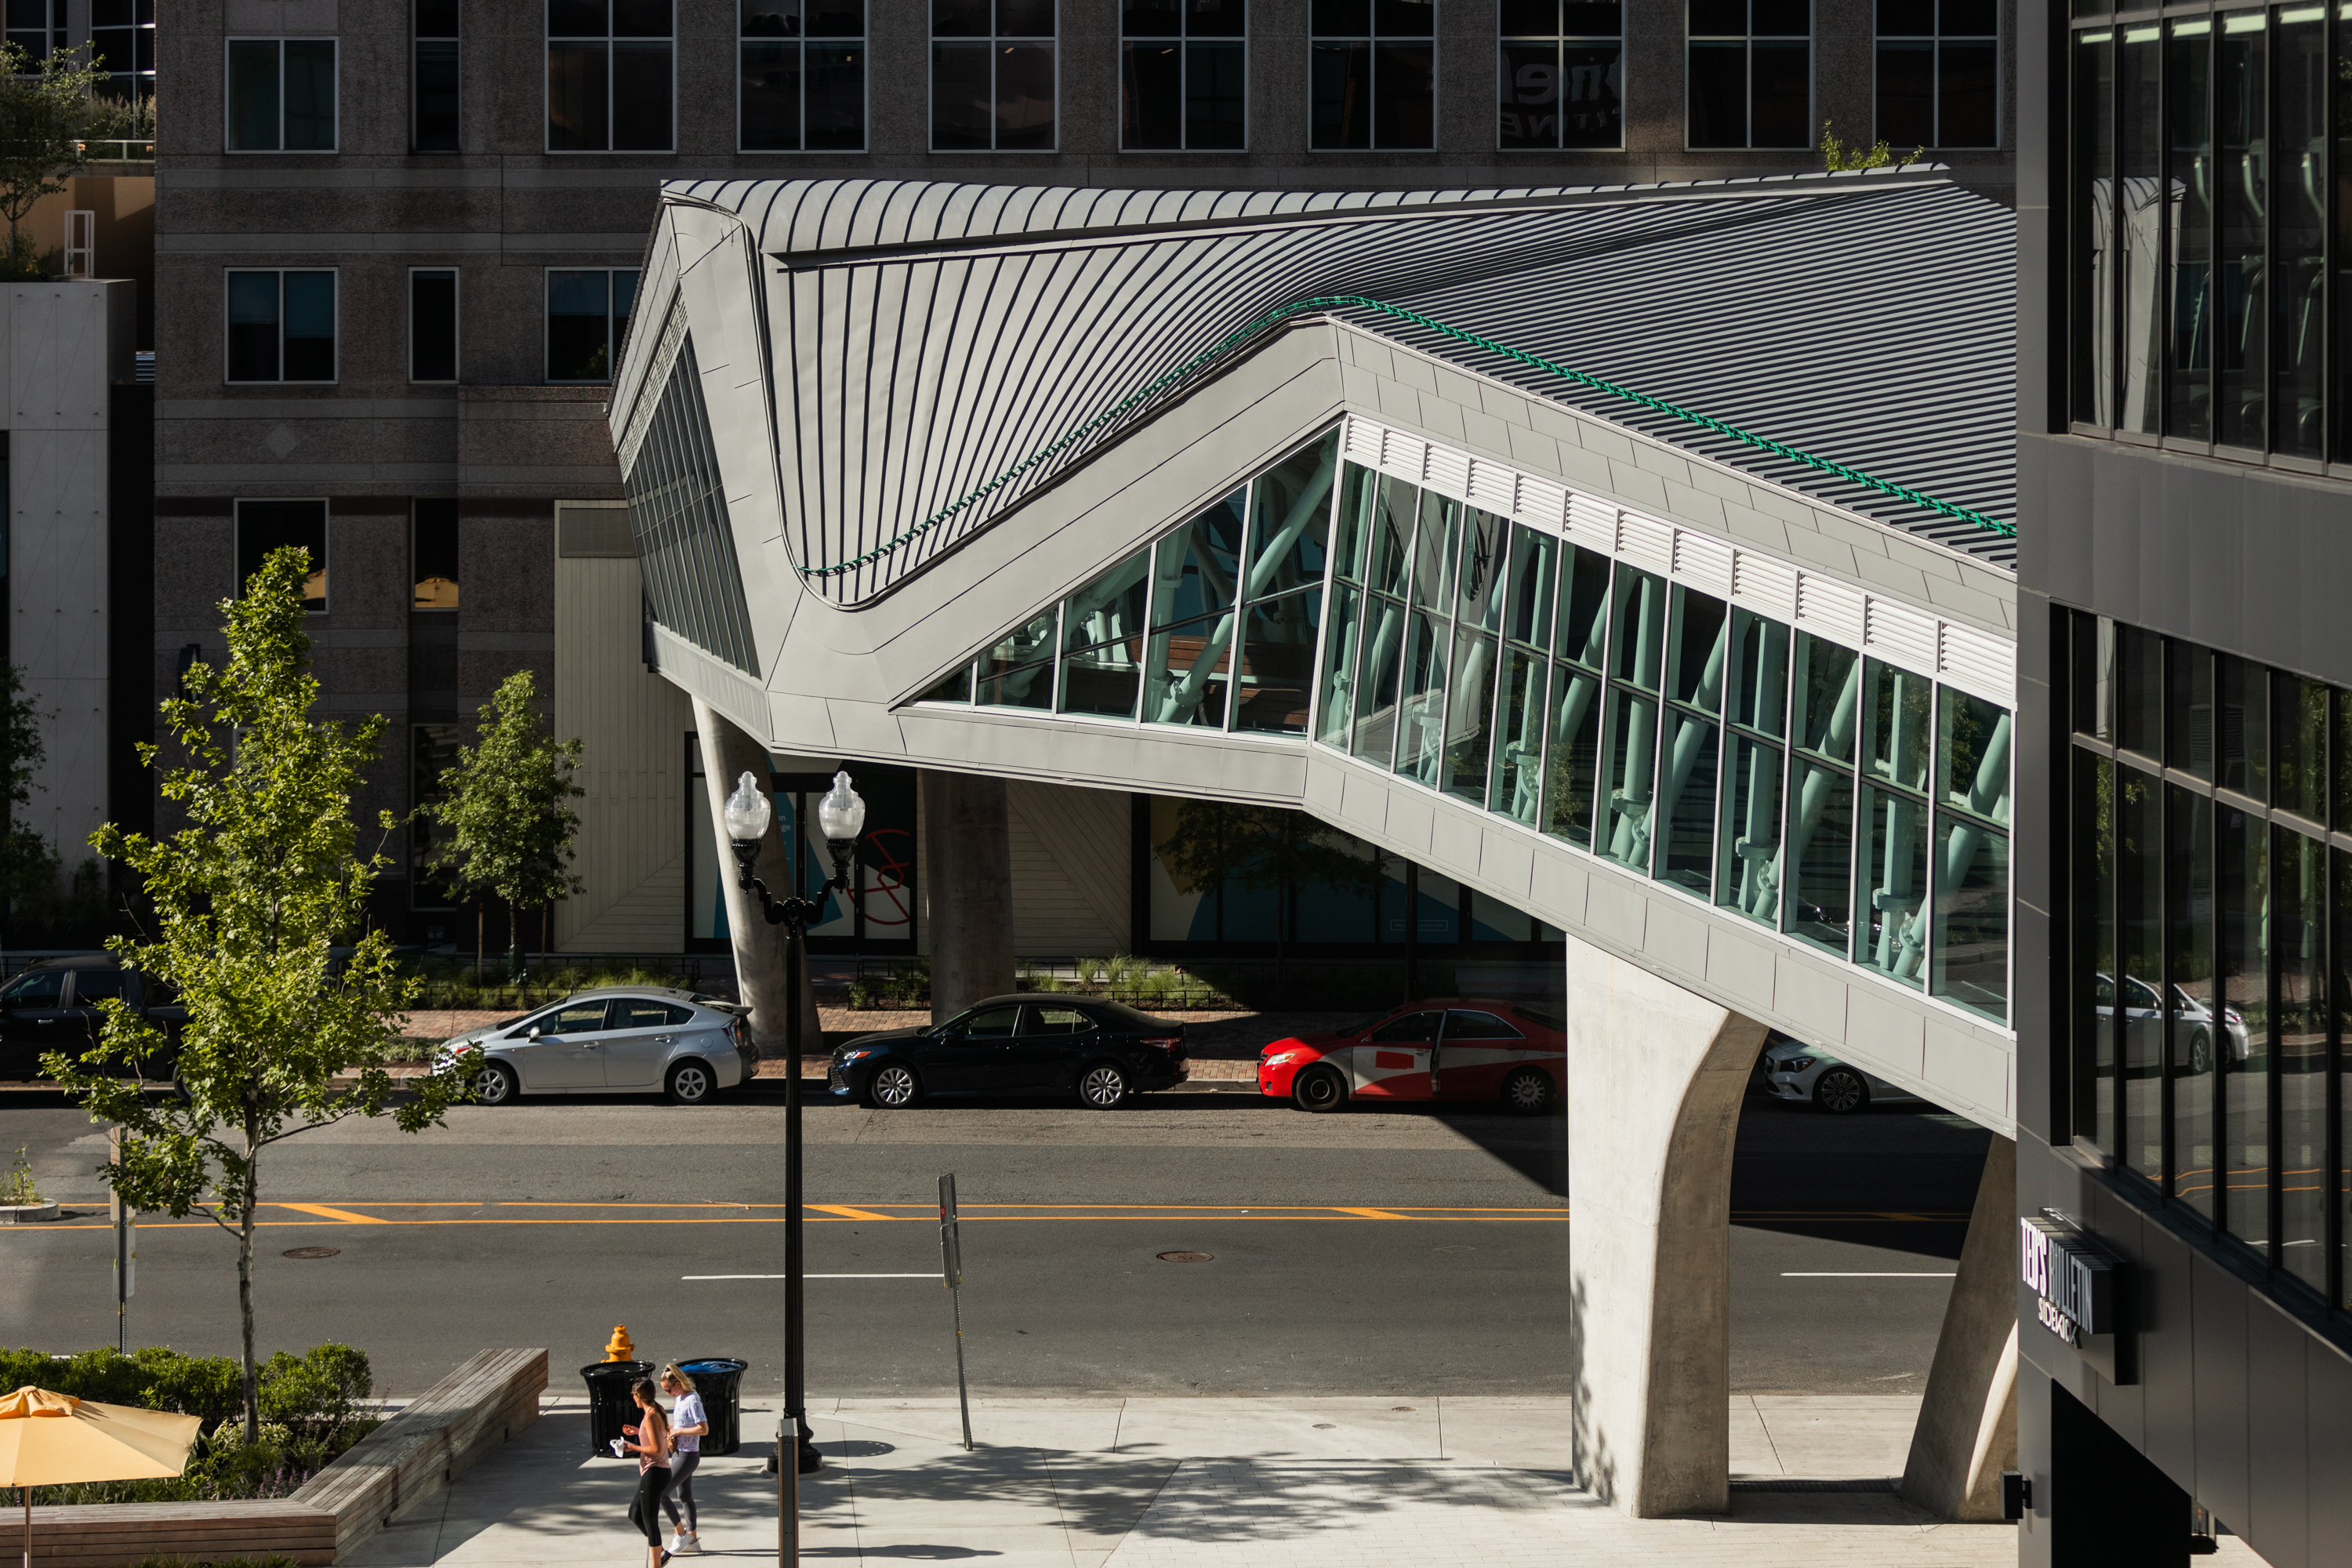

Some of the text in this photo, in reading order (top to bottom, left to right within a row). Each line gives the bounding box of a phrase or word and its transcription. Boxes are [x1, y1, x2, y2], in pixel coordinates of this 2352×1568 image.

[2020, 1217, 2092, 1334] TED'S BULLETIN
[2038, 1297, 2078, 1349] SIDEKICK
